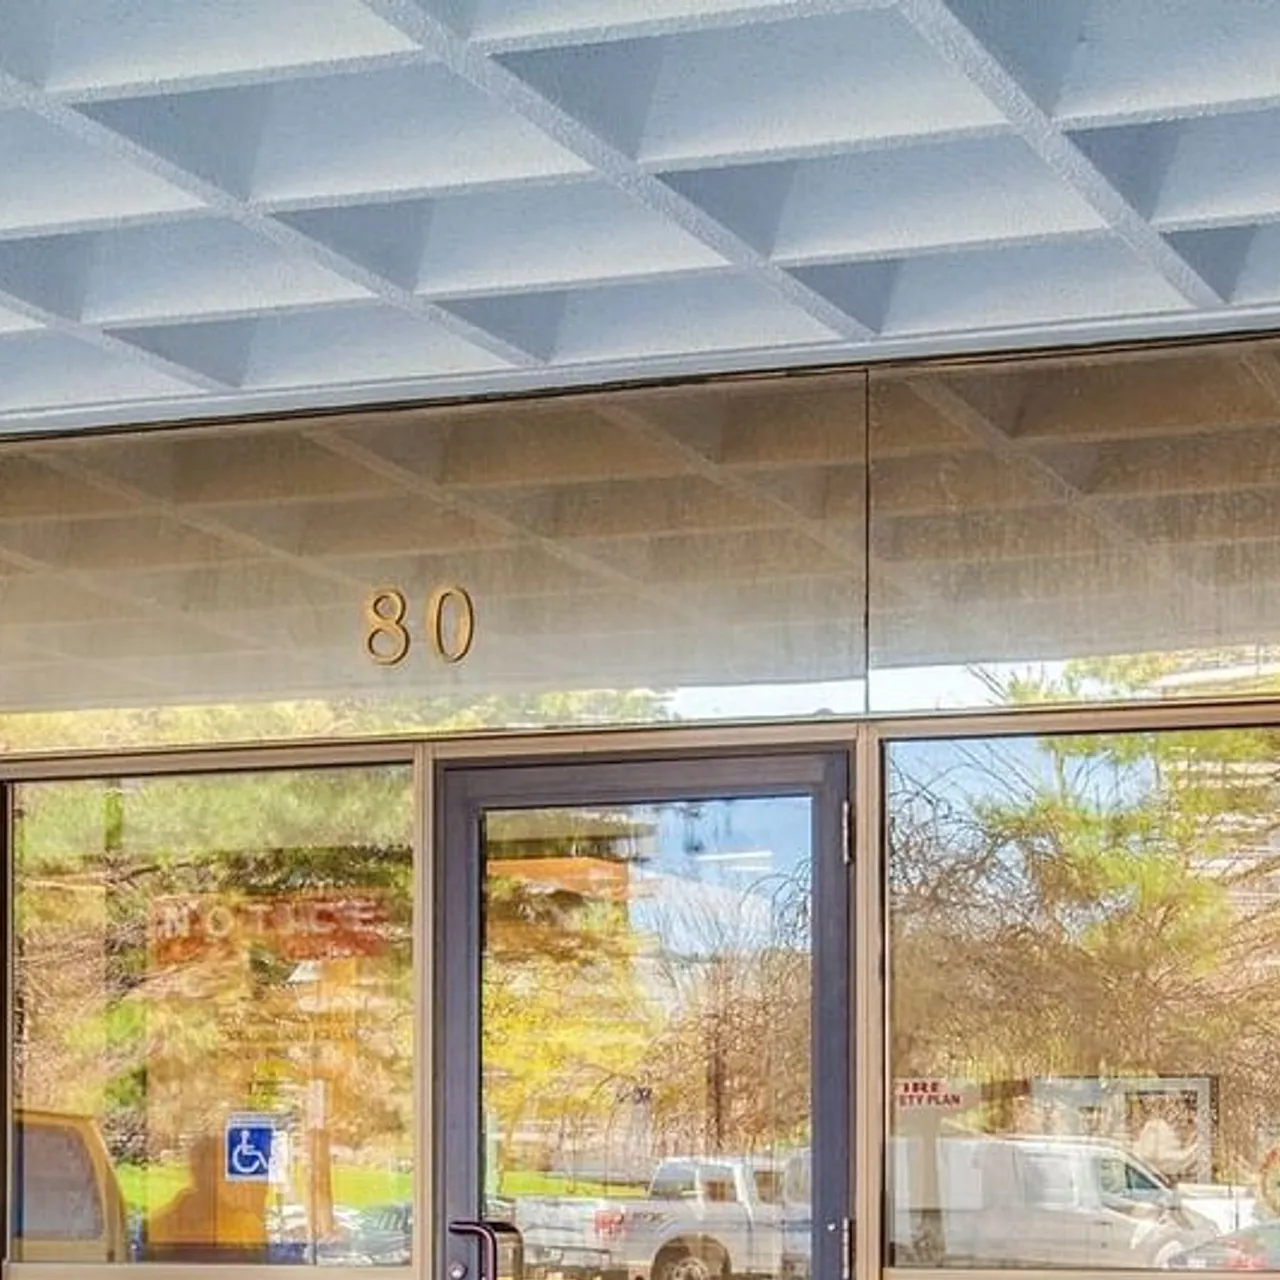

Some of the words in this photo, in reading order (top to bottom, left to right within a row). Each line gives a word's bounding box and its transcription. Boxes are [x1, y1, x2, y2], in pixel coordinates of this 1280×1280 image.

[365, 587, 474, 665] 80
[156, 898, 383, 937] NOTICE
[927, 1094, 961, 1105] PLAN
